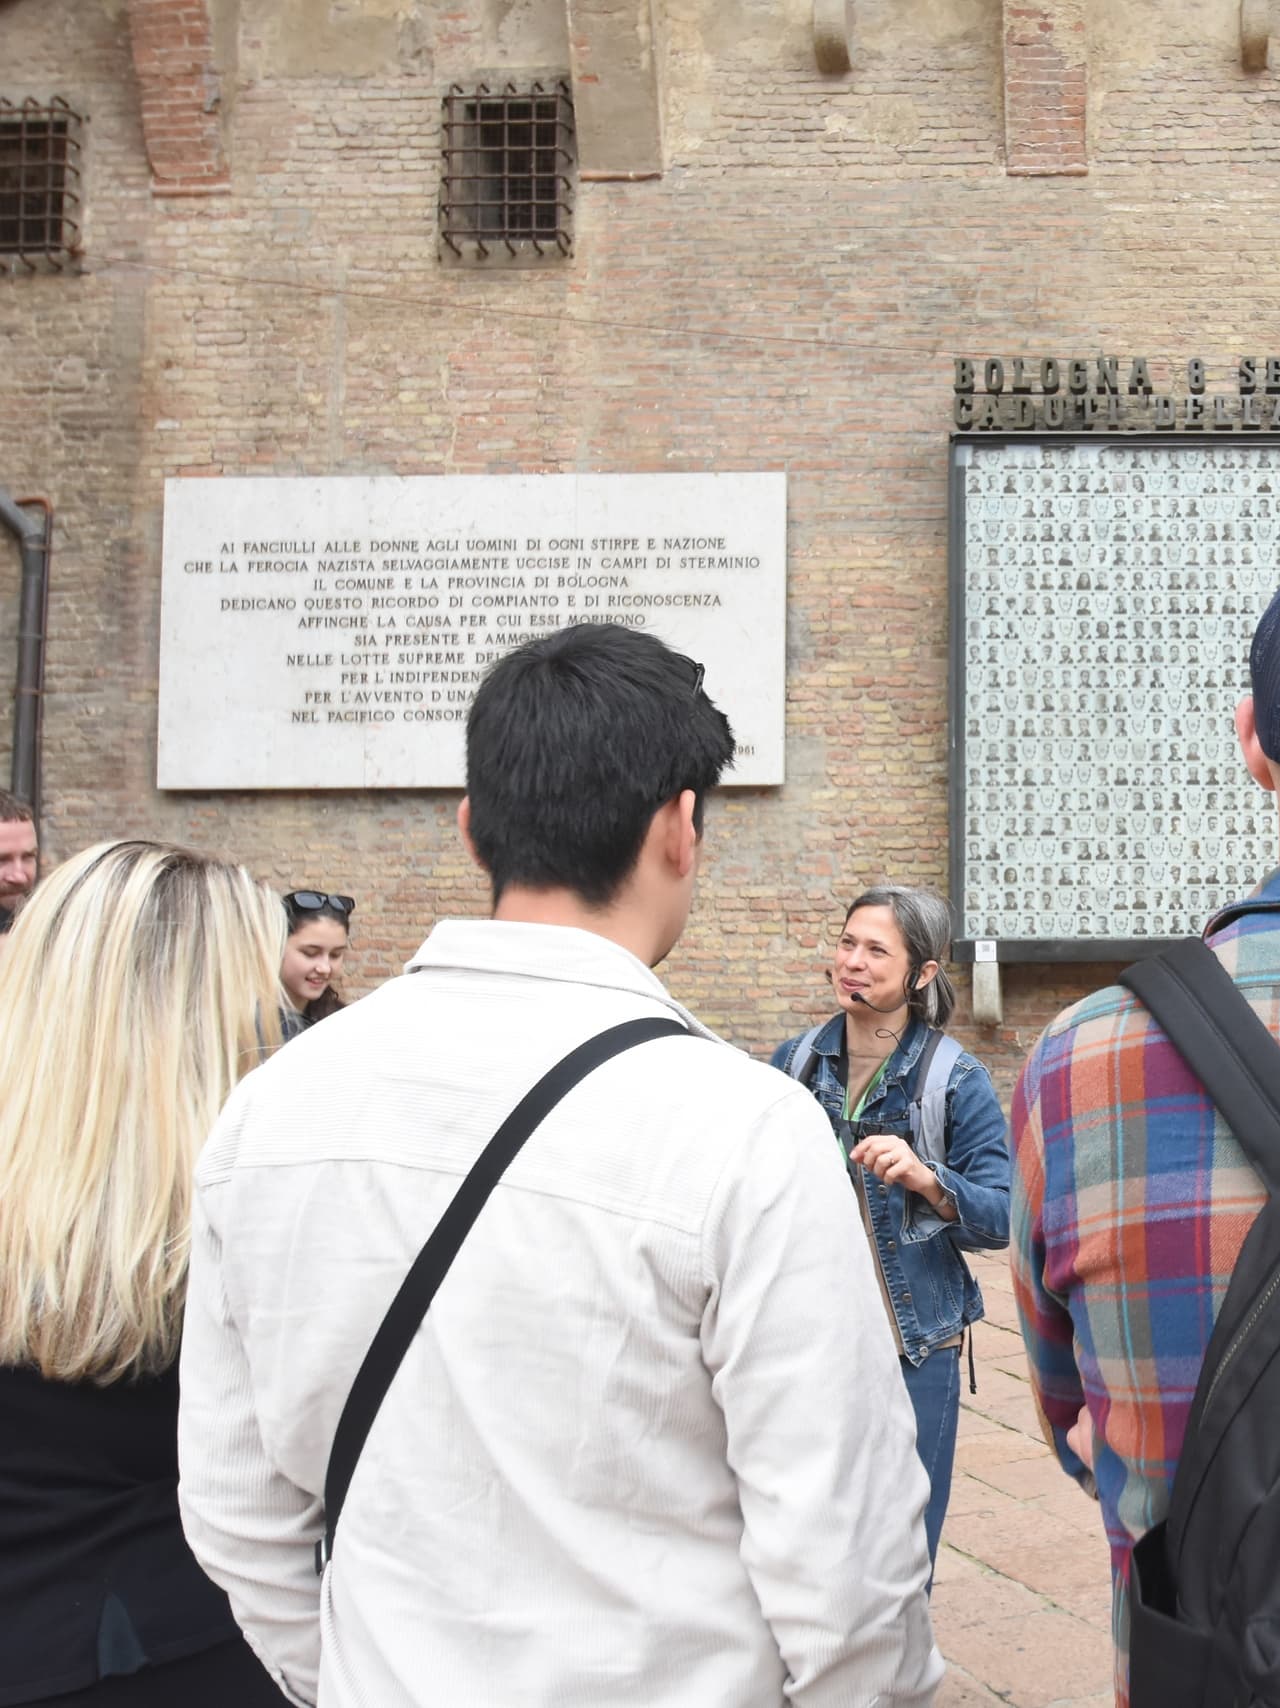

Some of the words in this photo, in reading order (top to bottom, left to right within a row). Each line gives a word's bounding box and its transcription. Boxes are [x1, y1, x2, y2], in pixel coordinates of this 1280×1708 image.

[954, 357, 1152, 394] BOLOGNA
[1187, 357, 1205, 394] 8
[953, 396, 1119, 430] CADUTI
[221, 542, 234, 554] AI
[243, 540, 315, 554] FANCIULLI
[324, 540, 361, 553] ALLE
[370, 540, 419, 554] DONNE
[426, 539, 459, 552] AGLI
[466, 539, 517, 552] UOMINI
[526, 539, 541, 551] DI
[548, 538, 584, 551] OGNI
[591, 538, 639, 551] STIRPE
[647, 538, 656, 550] E
[664, 537, 726, 550] NAZIONE
[184, 561, 212, 573] CHE
[220, 561, 238, 573] LA
[248, 560, 308, 573] FEROCIA
[318, 559, 375, 573] NAZISTA
[382, 557, 509, 571] SELVAGGIAMENTE
[516, 557, 570, 569] UCCISE
[577, 557, 591, 570] IN
[601, 557, 647, 569] CAMPI
[656, 557, 670, 569] DI
[680, 556, 760, 569] STERMINIO
[314, 578, 327, 591] IL
[335, 577, 395, 591] COMUNE
[405, 577, 412, 590] E
[421, 577, 438, 589] LA
[448, 576, 525, 589] PROVINCIA
[534, 576, 549, 589] DI
[557, 575, 629, 588] BOLOGNA
[221, 597, 296, 611] DEDICANO
[304, 597, 362, 611] QUESTO
[371, 595, 439, 609] RICORDO
[449, 595, 463, 608] DI
[472, 594, 559, 608] COMPIANTO
[568, 594, 576, 607] E
[584, 595, 599, 607] DI
[608, 594, 722, 608] RICONOSCENZA
[298, 616, 369, 630] AFFINCHE
[377, 616, 396, 628] LA
[405, 615, 451, 628] CAUSA
[460, 614, 487, 627] PER
[497, 614, 521, 627] CUI
[530, 614, 560, 627] ESSI
[566, 614, 645, 629] MORIRONO
[354, 634, 377, 647] SIA
[385, 632, 460, 647] PRESENTE
[467, 632, 476, 645] E
[287, 654, 333, 667] NELLE
[341, 653, 390, 666] LOTTE
[397, 651, 465, 665] SUPREME
[341, 672, 368, 685] PER
[374, 671, 480, 686] L'INDIPENDEN
[305, 690, 331, 704] PER
[292, 710, 320, 724] NEL
[328, 710, 395, 724] PACIFICO
